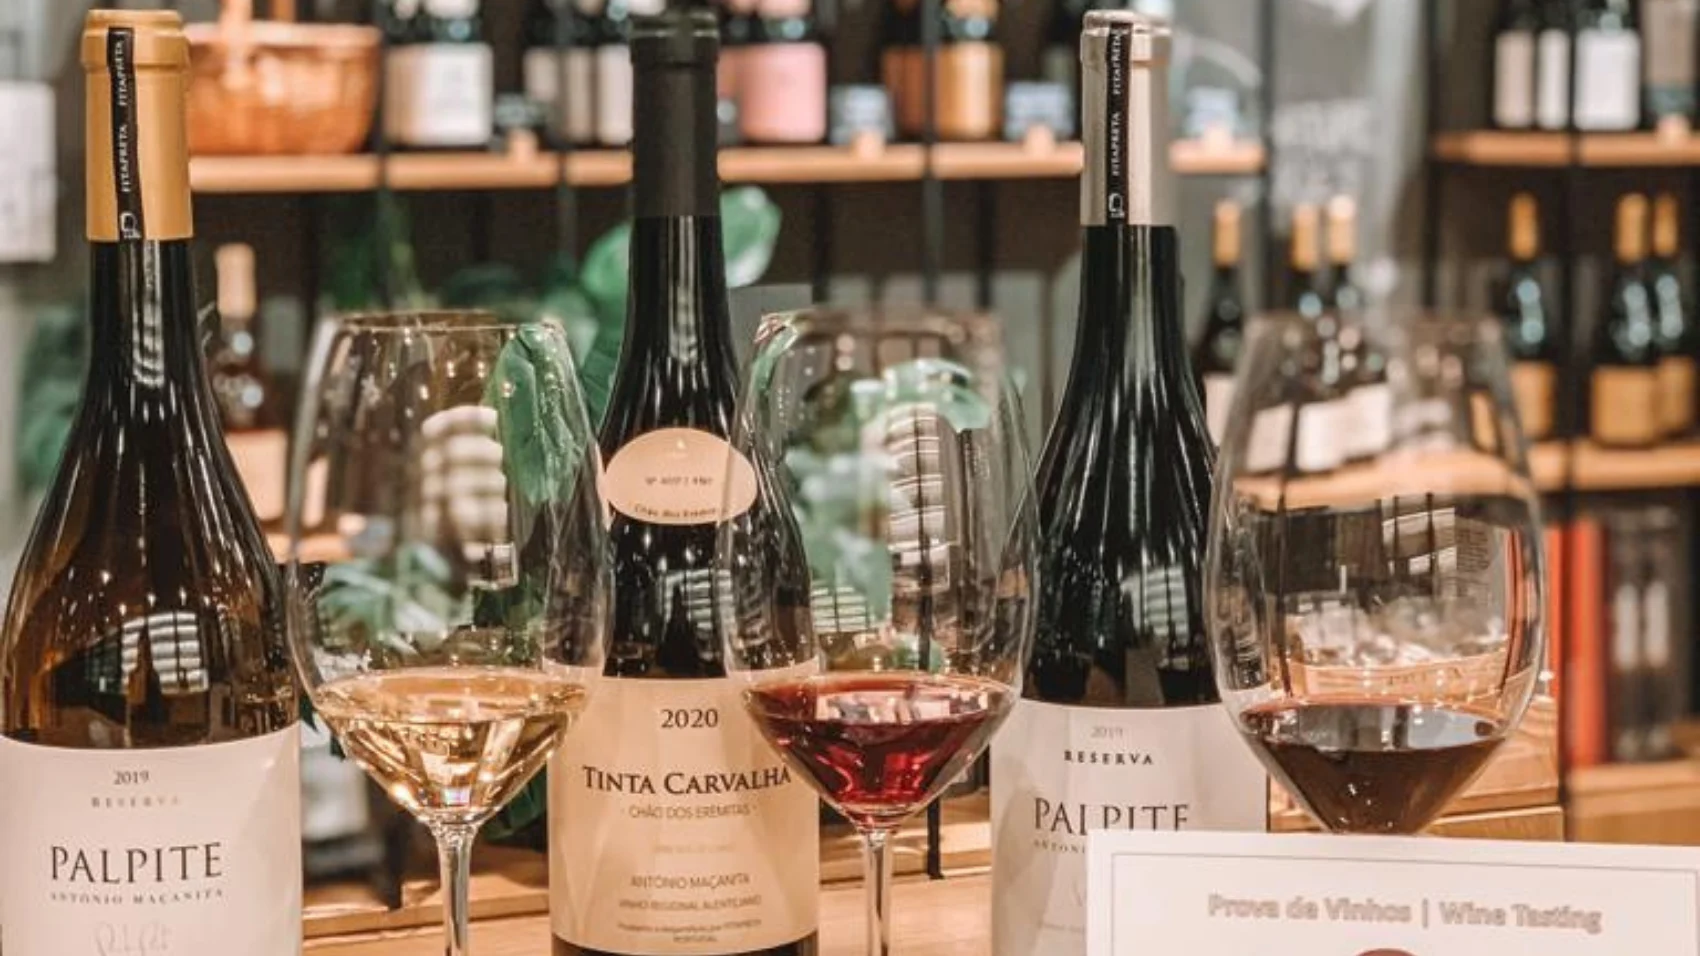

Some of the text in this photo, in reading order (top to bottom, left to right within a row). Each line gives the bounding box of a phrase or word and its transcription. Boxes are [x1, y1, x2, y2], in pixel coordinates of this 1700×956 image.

[115, 41, 128, 106] FITAPRETA
[1110, 111, 1121, 176] FITAPRETA
[118, 124, 131, 192] FITAPRETA
[660, 708, 719, 729] 2020
[1091, 726, 1124, 739] 2019
[1063, 750, 1154, 765] RESERVA
[113, 770, 150, 785] 2019
[582, 765, 792, 795] TINTA CARVALHA
[91, 795, 181, 809] RESERVA
[666, 806, 694, 820] DOS
[695, 802, 751, 818] EREMITAS
[50, 841, 223, 885] PALPITE
[689, 872, 751, 890] MAÇANITA
[1208, 893, 1280, 918] Prova
[1286, 896, 1319, 919] de
[1324, 897, 1412, 923] Vinhos
[1438, 901, 1507, 926] Wine
[1510, 903, 1603, 934] Tasting
